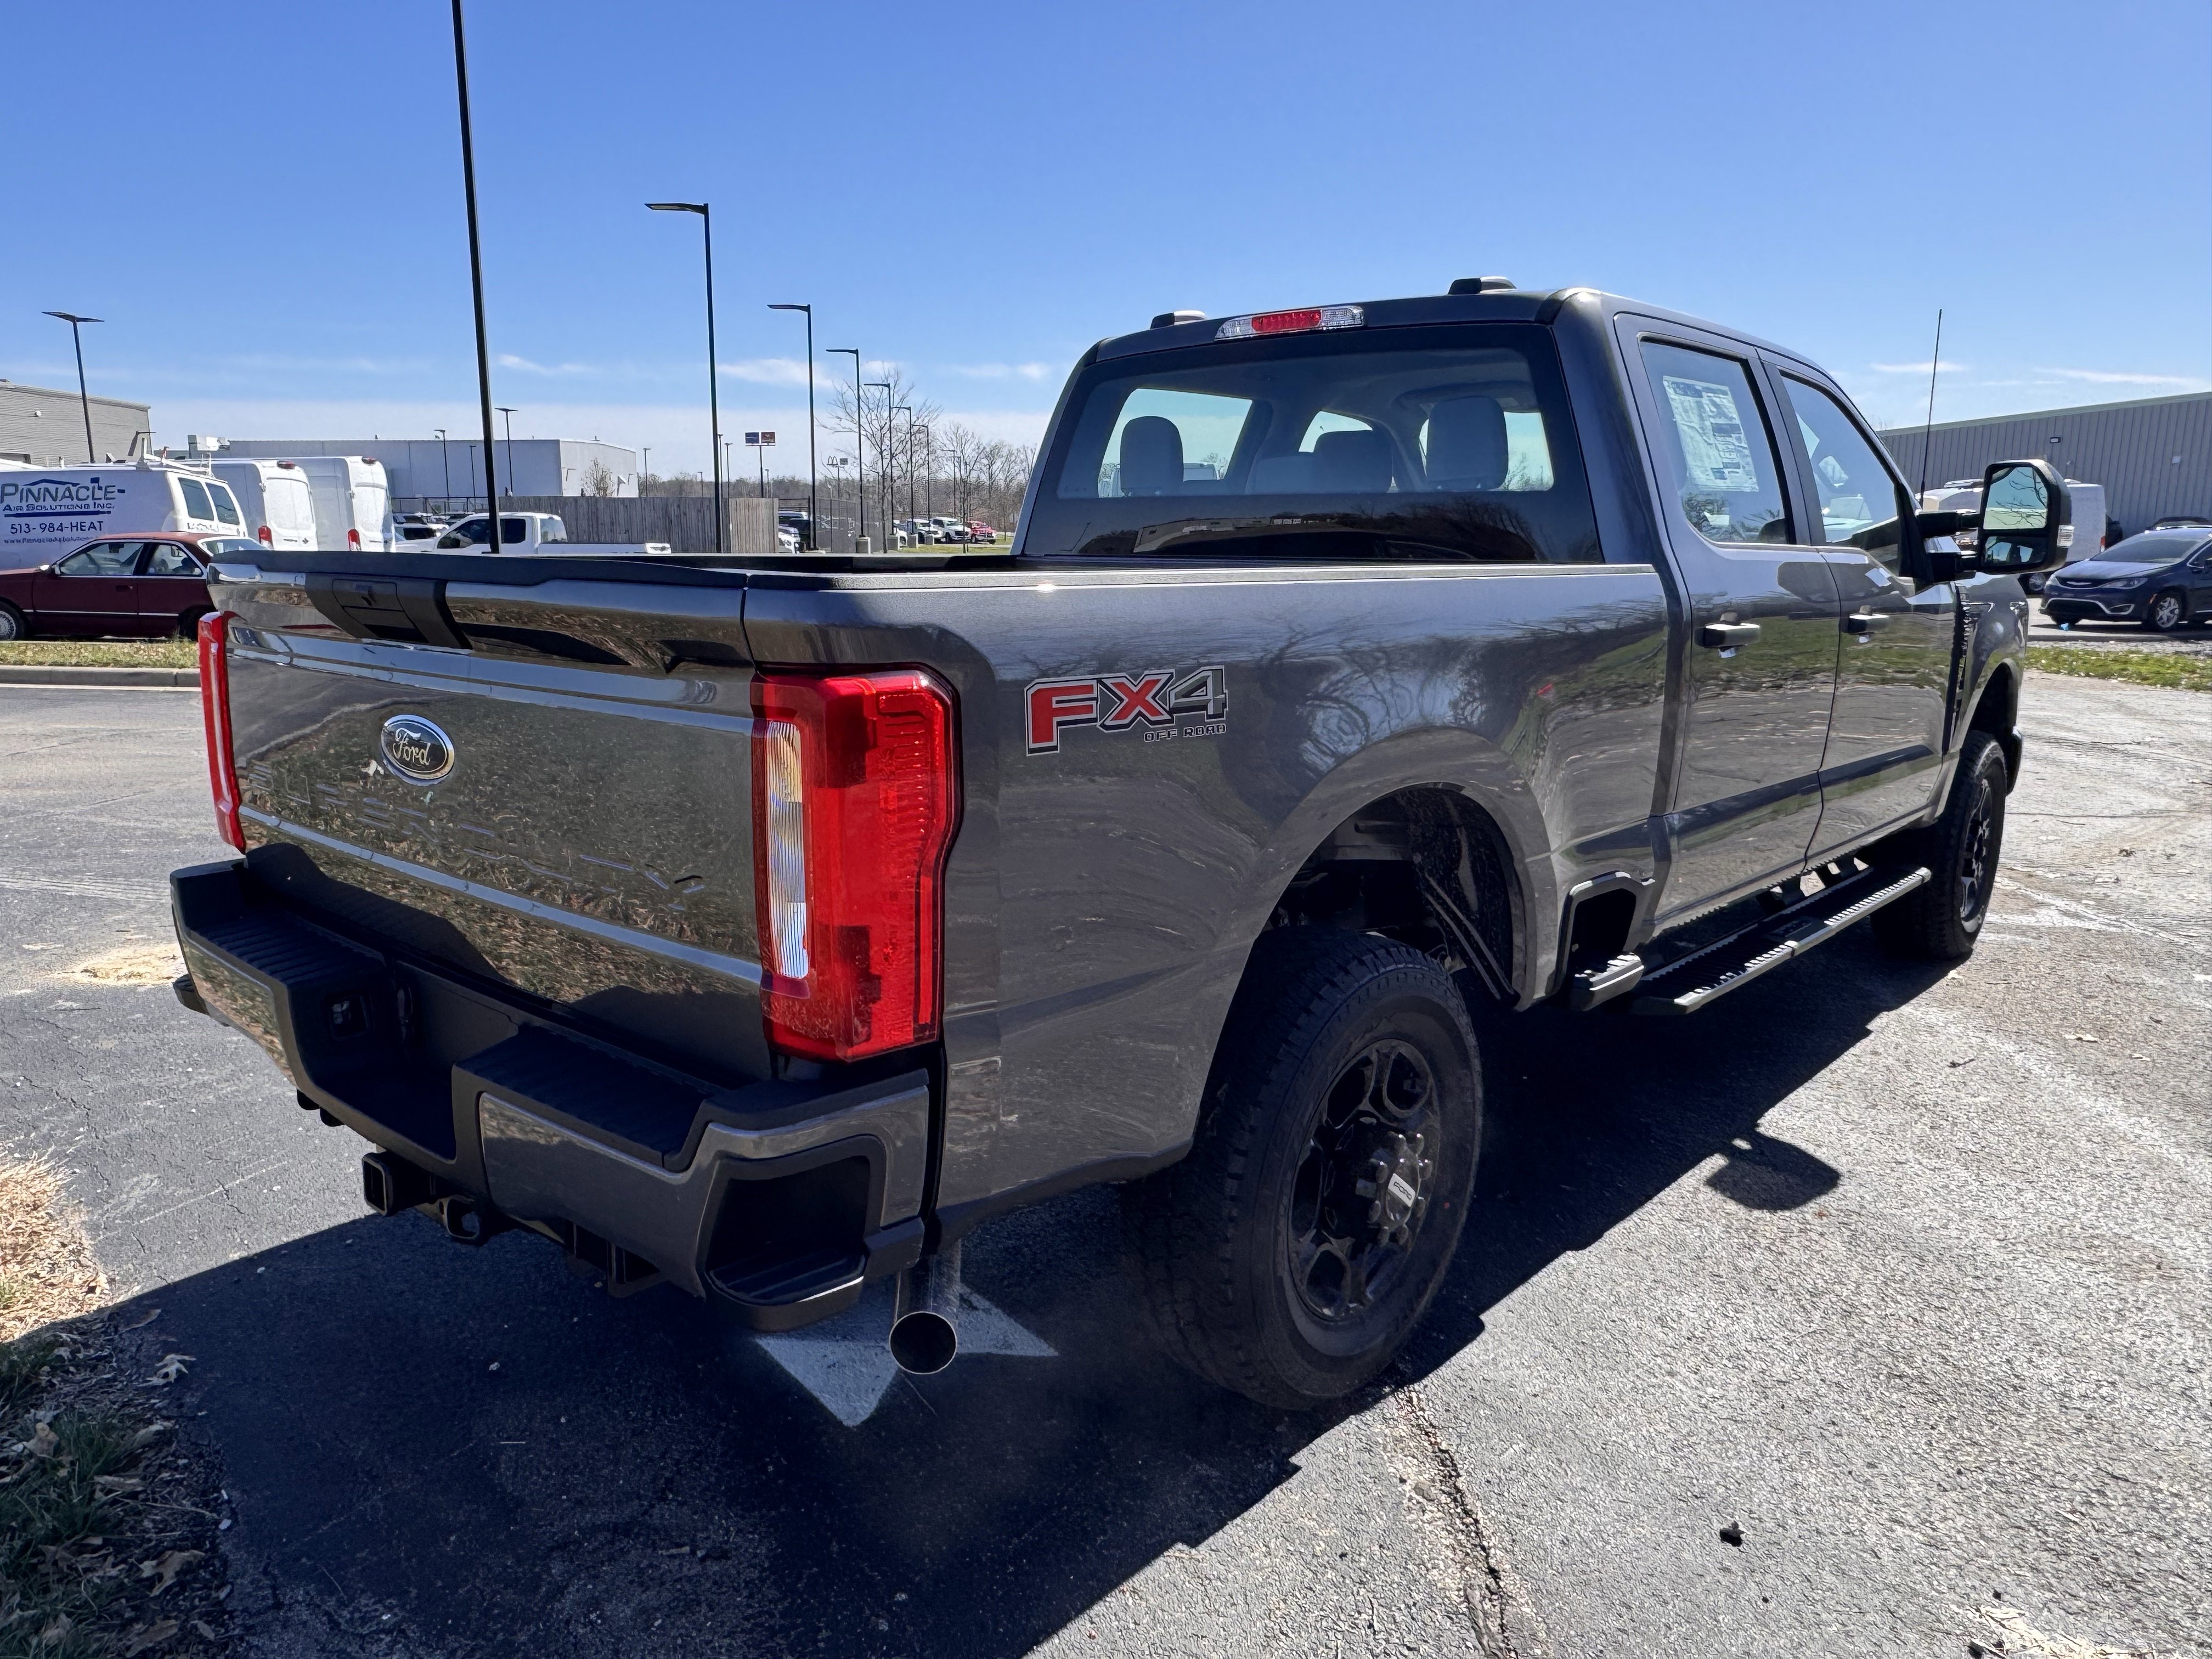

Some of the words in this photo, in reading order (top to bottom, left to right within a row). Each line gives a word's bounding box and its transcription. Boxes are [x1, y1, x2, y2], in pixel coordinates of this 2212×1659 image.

[0, 483, 116, 504] PINNACLE
[10, 521, 104, 534] 513-984-HEAT
[1024, 665, 1228, 757] FX4
[1144, 728, 1178, 743] OFF
[1183, 723, 1227, 738] ROAD
[392, 727, 431, 766] Ford
